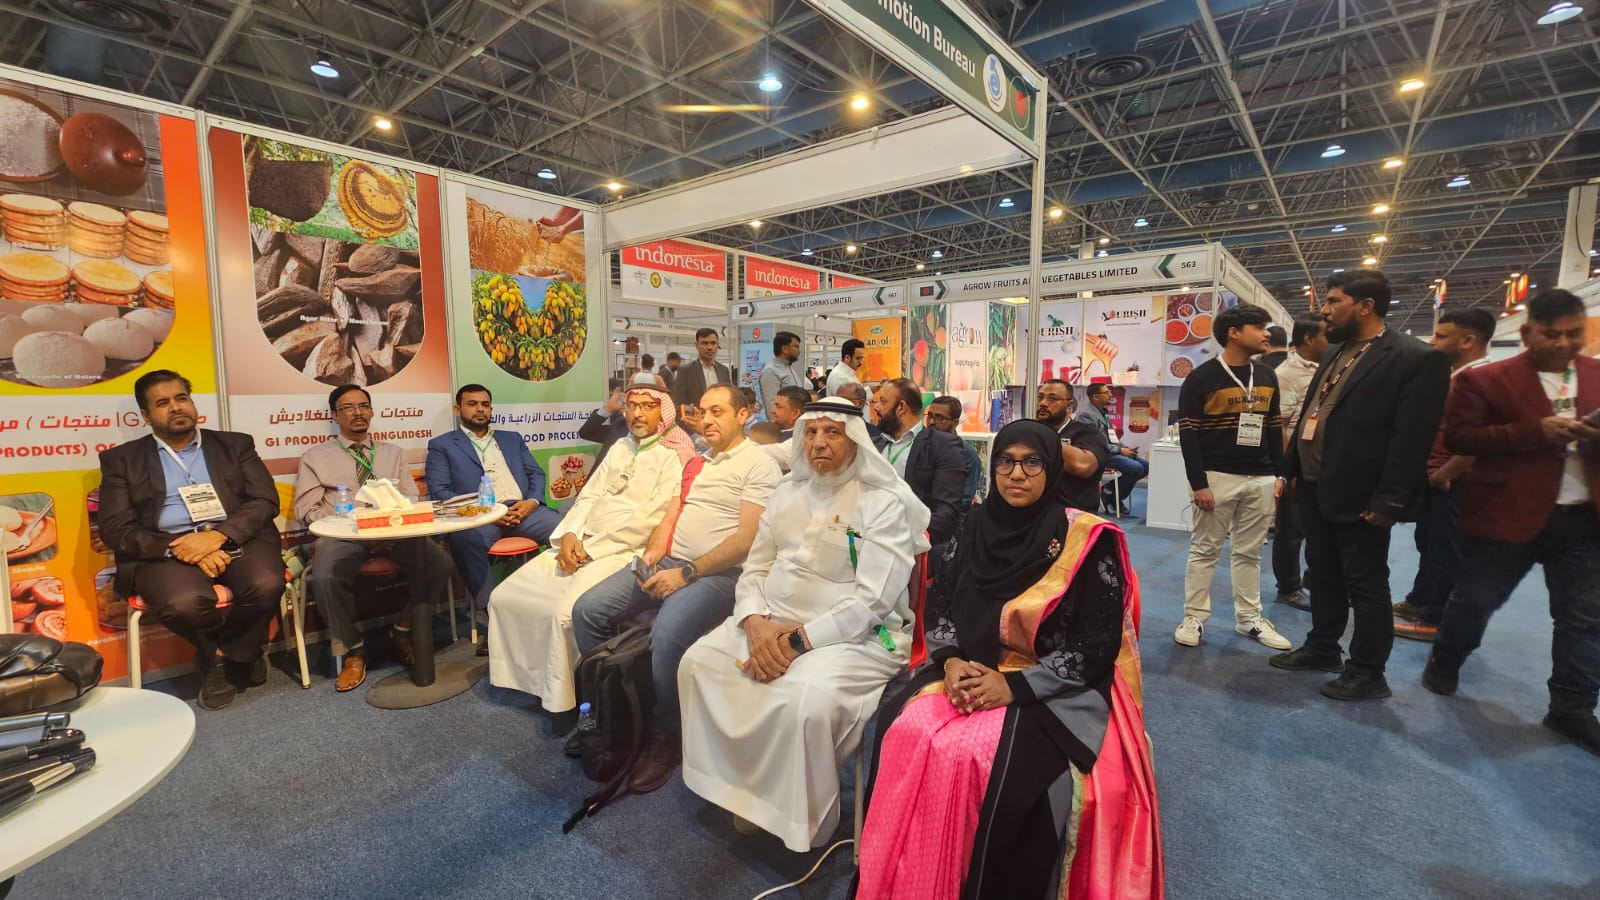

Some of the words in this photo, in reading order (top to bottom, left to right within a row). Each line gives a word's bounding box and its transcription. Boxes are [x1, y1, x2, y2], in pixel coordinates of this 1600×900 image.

[933, 25, 976, 78] Bureau
[634, 246, 714, 273] indonesia
[755, 268, 810, 290] indonesia
[964, 282, 992, 291] AGROW
[993, 278, 1020, 288] FRUITS
[1042, 270, 1097, 284] VEGETABLES
[1099, 266, 1138, 278] LIMITED
[829, 296, 852, 305] LIMITED
[381, 407, 423, 421] منتجات
[40, 415, 111, 432] منتجات
[265, 437, 280, 447] GI
[523, 433, 545, 443] OOD
